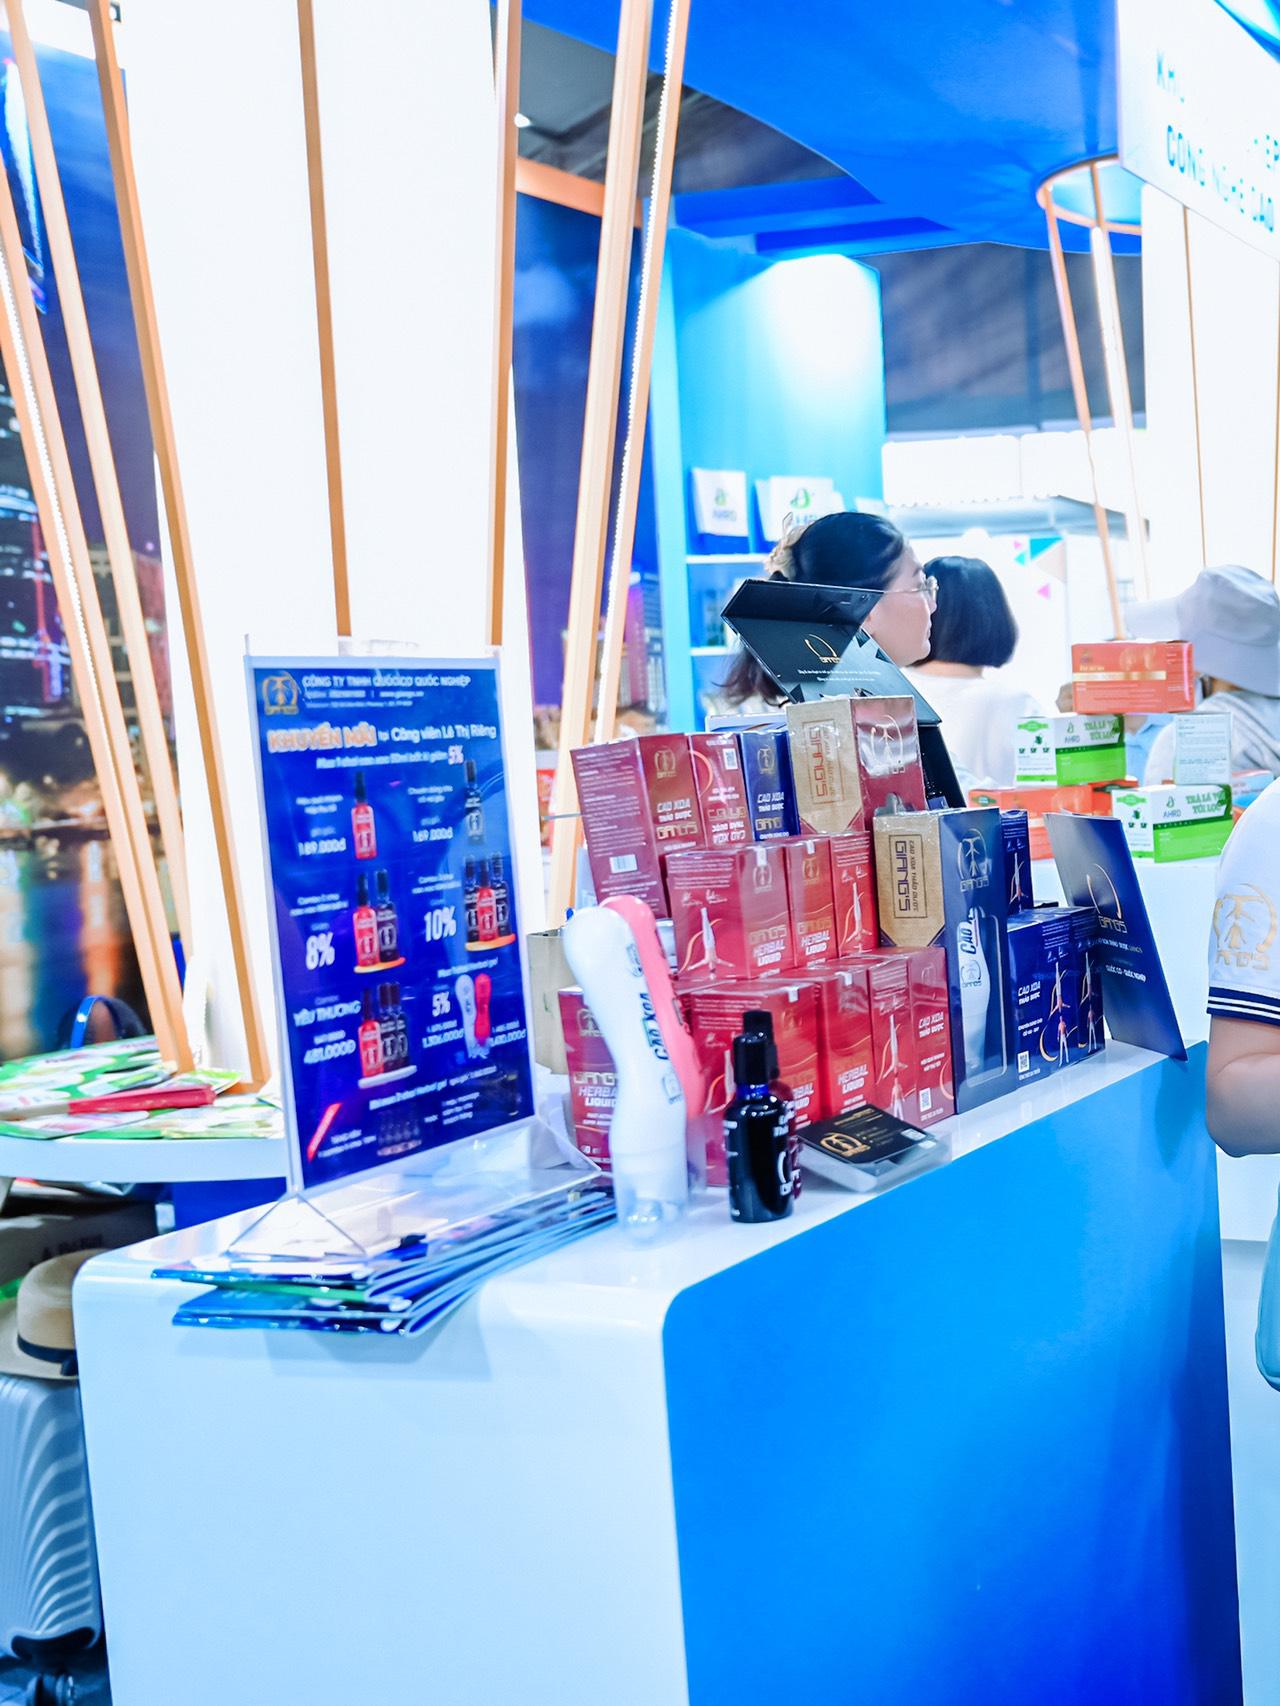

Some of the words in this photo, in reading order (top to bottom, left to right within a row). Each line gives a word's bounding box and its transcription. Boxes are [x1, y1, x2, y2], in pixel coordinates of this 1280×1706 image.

[657, 801, 674, 813] CAO
[674, 798, 691, 811] XOA
[757, 793, 771, 804] CAO
[771, 791, 785, 802] XOA
[895, 840, 911, 912] GIANG'S
[424, 905, 457, 943] 10%
[753, 940, 785, 958] HERBAL
[960, 926, 977, 955] CAO
[306, 931, 335, 970] 8%
[1018, 987, 1030, 996] CAO
[1030, 981, 1041, 993] XOA
[432, 991, 451, 1017] 5%
[918, 1017, 931, 1029] CAO
[930, 1011, 944, 1025] XOA
[578, 1085, 617, 1097] HERBA
